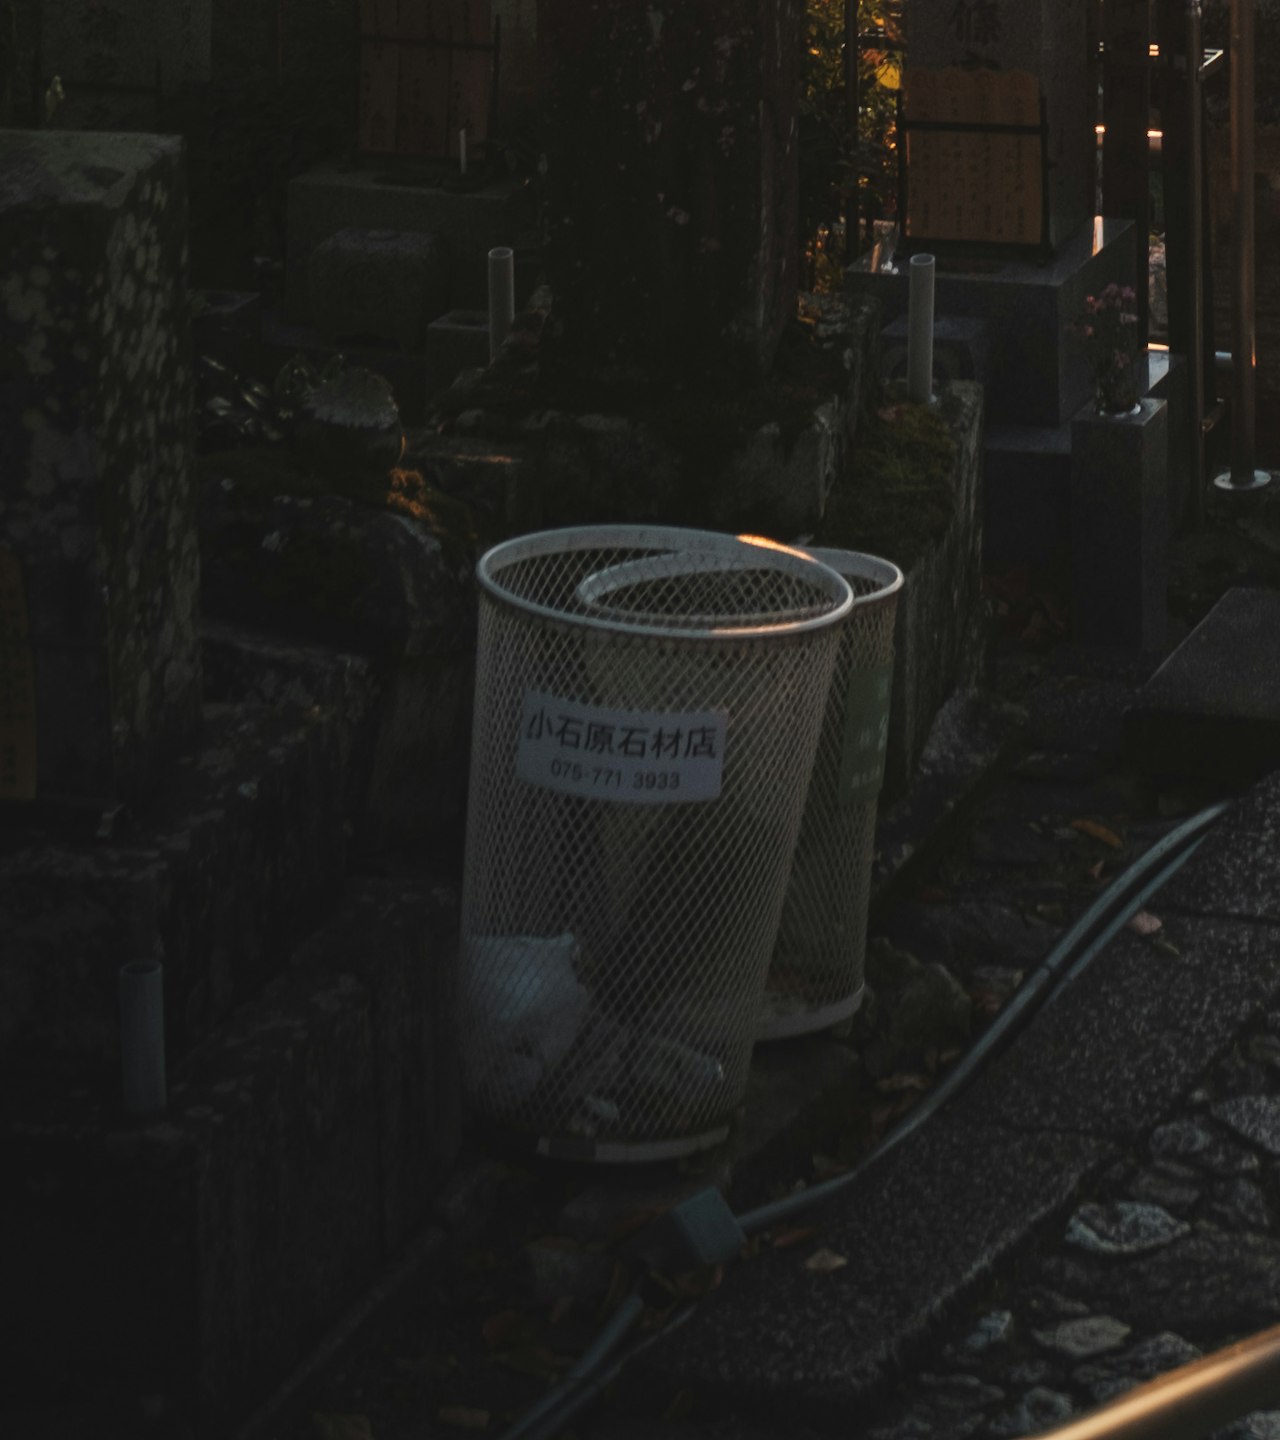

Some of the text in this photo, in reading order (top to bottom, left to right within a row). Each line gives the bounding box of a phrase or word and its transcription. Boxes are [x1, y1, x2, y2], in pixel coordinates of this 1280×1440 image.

[526, 706, 717, 759] 小石原石材店
